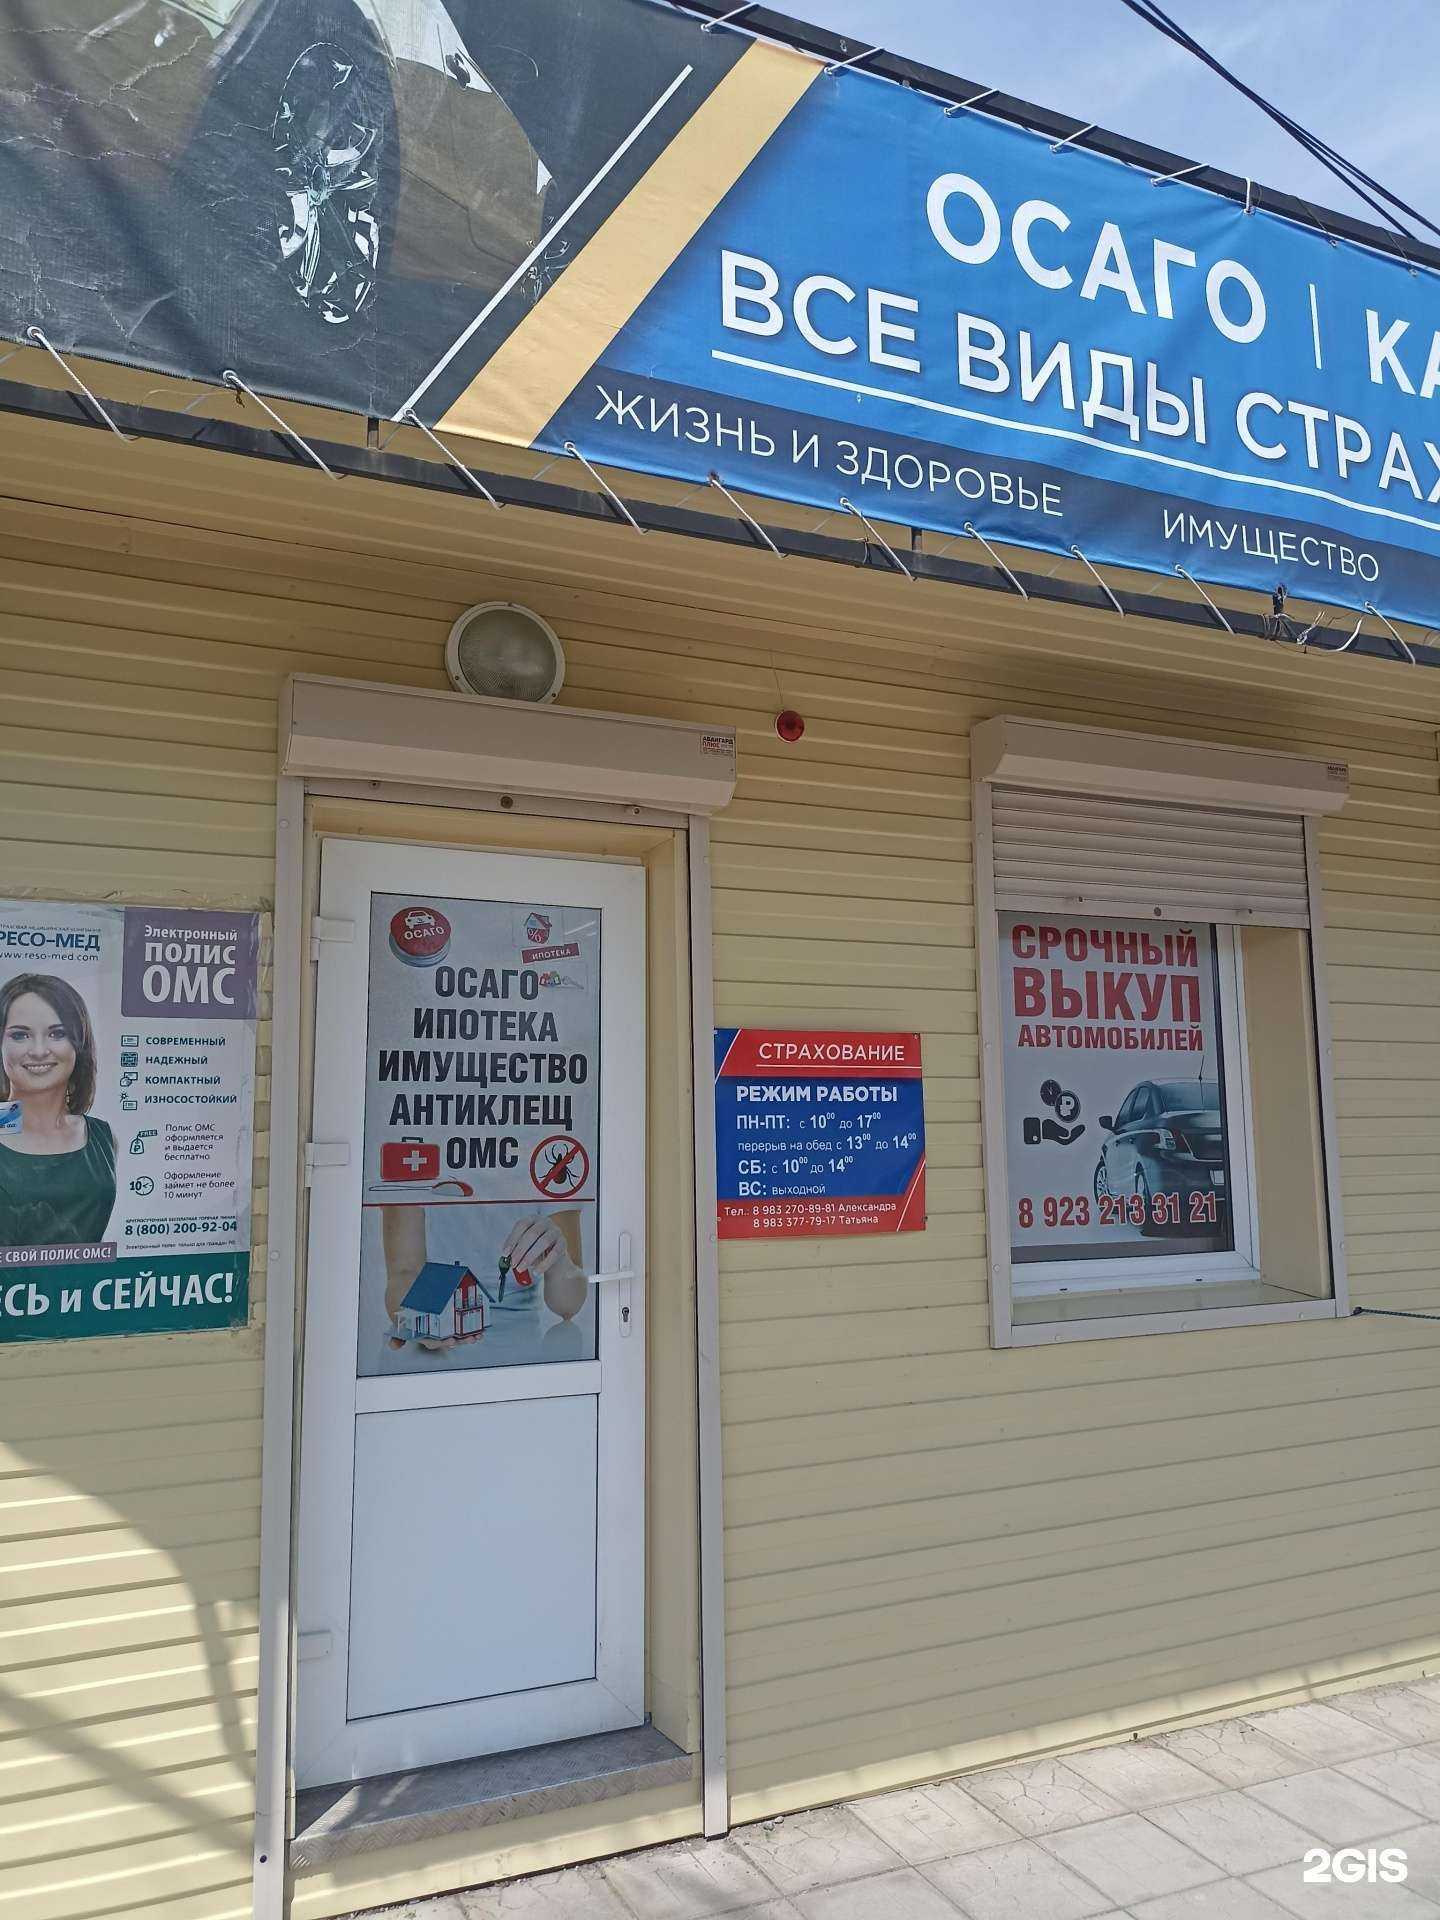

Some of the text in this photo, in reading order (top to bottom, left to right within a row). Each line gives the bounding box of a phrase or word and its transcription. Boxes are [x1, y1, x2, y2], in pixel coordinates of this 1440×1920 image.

[925, 172, 1267, 344] ОСАГО
[720, 248, 921, 373] ВСЕ
[956, 312, 1207, 445] ВИДЫ
[595, 385, 1064, 518] ЖИЗНЬ И ЗДОРОВЬЕ
[1163, 510, 1380, 583] ИМУЩЕСТВО
[144, 925, 238, 942] Электронный
[404, 926, 444, 939] ОСАГО
[1012, 924, 1199, 967] СРОЧНЫЙ
[532, 948, 571, 960] ИПОТЕКА
[142, 965, 236, 1005] ОМС
[435, 966, 538, 1000] ОСАГО
[1013, 966, 1201, 1022] ВЫКУП
[414, 1008, 559, 1042] ИПОТЕКА
[145, 1036, 226, 1046] СОВРЕМЕННЫЙ
[1018, 1024, 1203, 1051] АВТОМОБИЛЕЙ
[145, 1055, 208, 1065] НАДЕЖНЫЙ
[759, 1043, 904, 1061] СТРАХОВАНИЕ
[379, 1050, 588, 1088] ИМУЩЕСТВО
[145, 1075, 221, 1085] КОМПАКТНЫЙ
[145, 1094, 237, 1104] ИЗНОСОСТОЙКИЙ
[736, 1086, 897, 1102] РЕЖИМ РАБОТЫ
[389, 1094, 572, 1131] АНТИКЛЕЩ
[736, 1115, 790, 1130] ПН-ПТ:
[799, 1120, 805, 1129] с
[840, 1120, 852, 1130] до
[446, 1137, 519, 1169] ОМС
[738, 1142, 787, 1153] перерыв
[790, 1142, 803, 1151] на
[806, 1140, 832, 1152] обед
[836, 1141, 841, 1150] с
[876, 1141, 888, 1150] до
[738, 1160, 767, 1174] СБ:
[772, 1165, 777, 1174] с
[810, 1165, 823, 1174] до
[164, 1172, 221, 1180] Оформление
[209, 1180, 234, 1188] более
[130, 1181, 141, 1190] 10
[738, 1182, 825, 1196] ВС: выходной
[753, 1207, 758, 1215] 8
[762, 1205, 781, 1215] 983
[785, 1204, 835, 1214] 270-89-81
[838, 1203, 896, 1212] Александра
[1018, 1191, 1217, 1228] 8 923 213 31 21
[125, 1221, 237, 1236] 8 (800) 200-92-04
[753, 1216, 878, 1228] 8 983 377-79-17 Татьяна
[6, 1249, 37, 1262] СВОЙ
[41, 1249, 80, 1260] ПОЛИС
[83, 1248, 111, 1258] ОМС!
[0, 1272, 234, 1317] СЬ и СЕЙЧАС!
